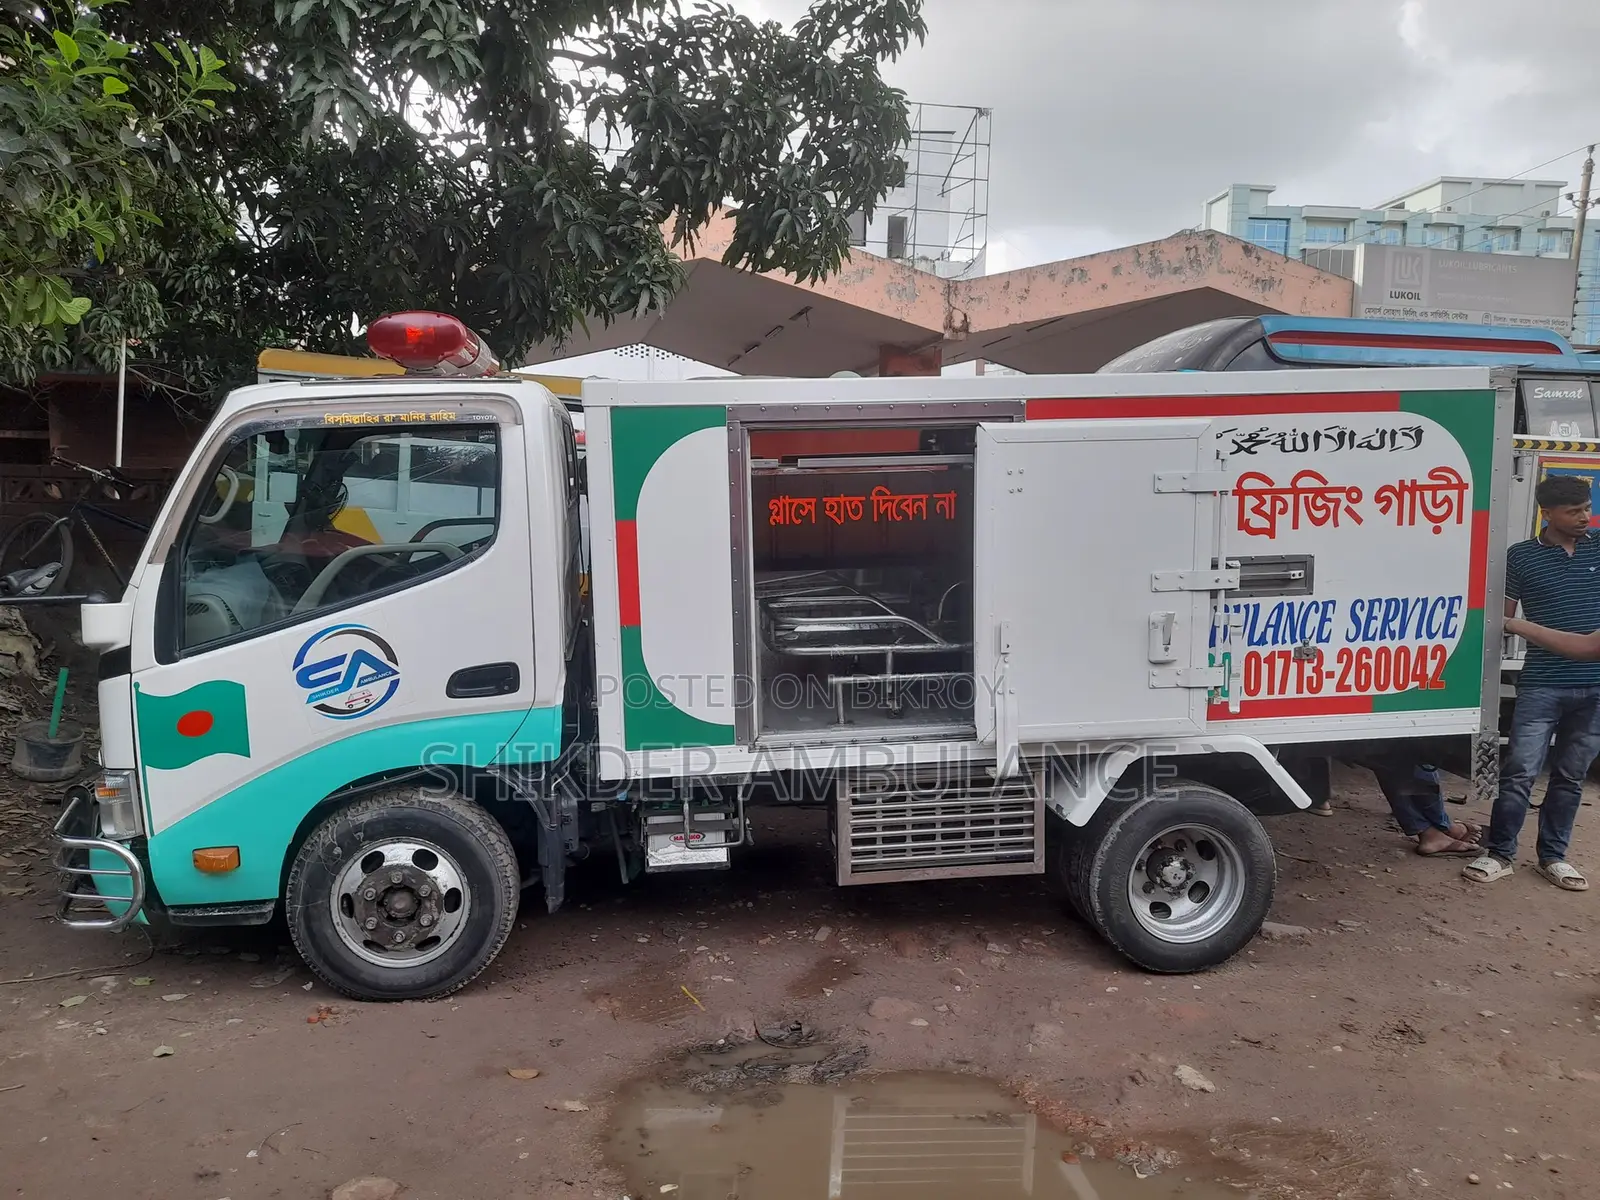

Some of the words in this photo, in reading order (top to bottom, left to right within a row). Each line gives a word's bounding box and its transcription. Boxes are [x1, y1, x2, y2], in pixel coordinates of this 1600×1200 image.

[1389, 290, 1421, 301] LUKOIL
[1533, 387, 1583, 399] Samrat
[429, 409, 456, 421] রাহিম
[768, 495, 817, 526] গ্লাসে
[823, 493, 866, 525] হাত
[870, 485, 928, 522] দিবেন
[933, 490, 957, 520] না
[1232, 469, 1364, 540] ফ্রিজিং
[1374, 466, 1469, 535] গাড়ী
[1345, 595, 1463, 644] SERVICE
[360, 670, 393, 685] AMBULANCE
[1244, 644, 1447, 697] 01713-260042
[311, 687, 340, 700] SHIKDER
